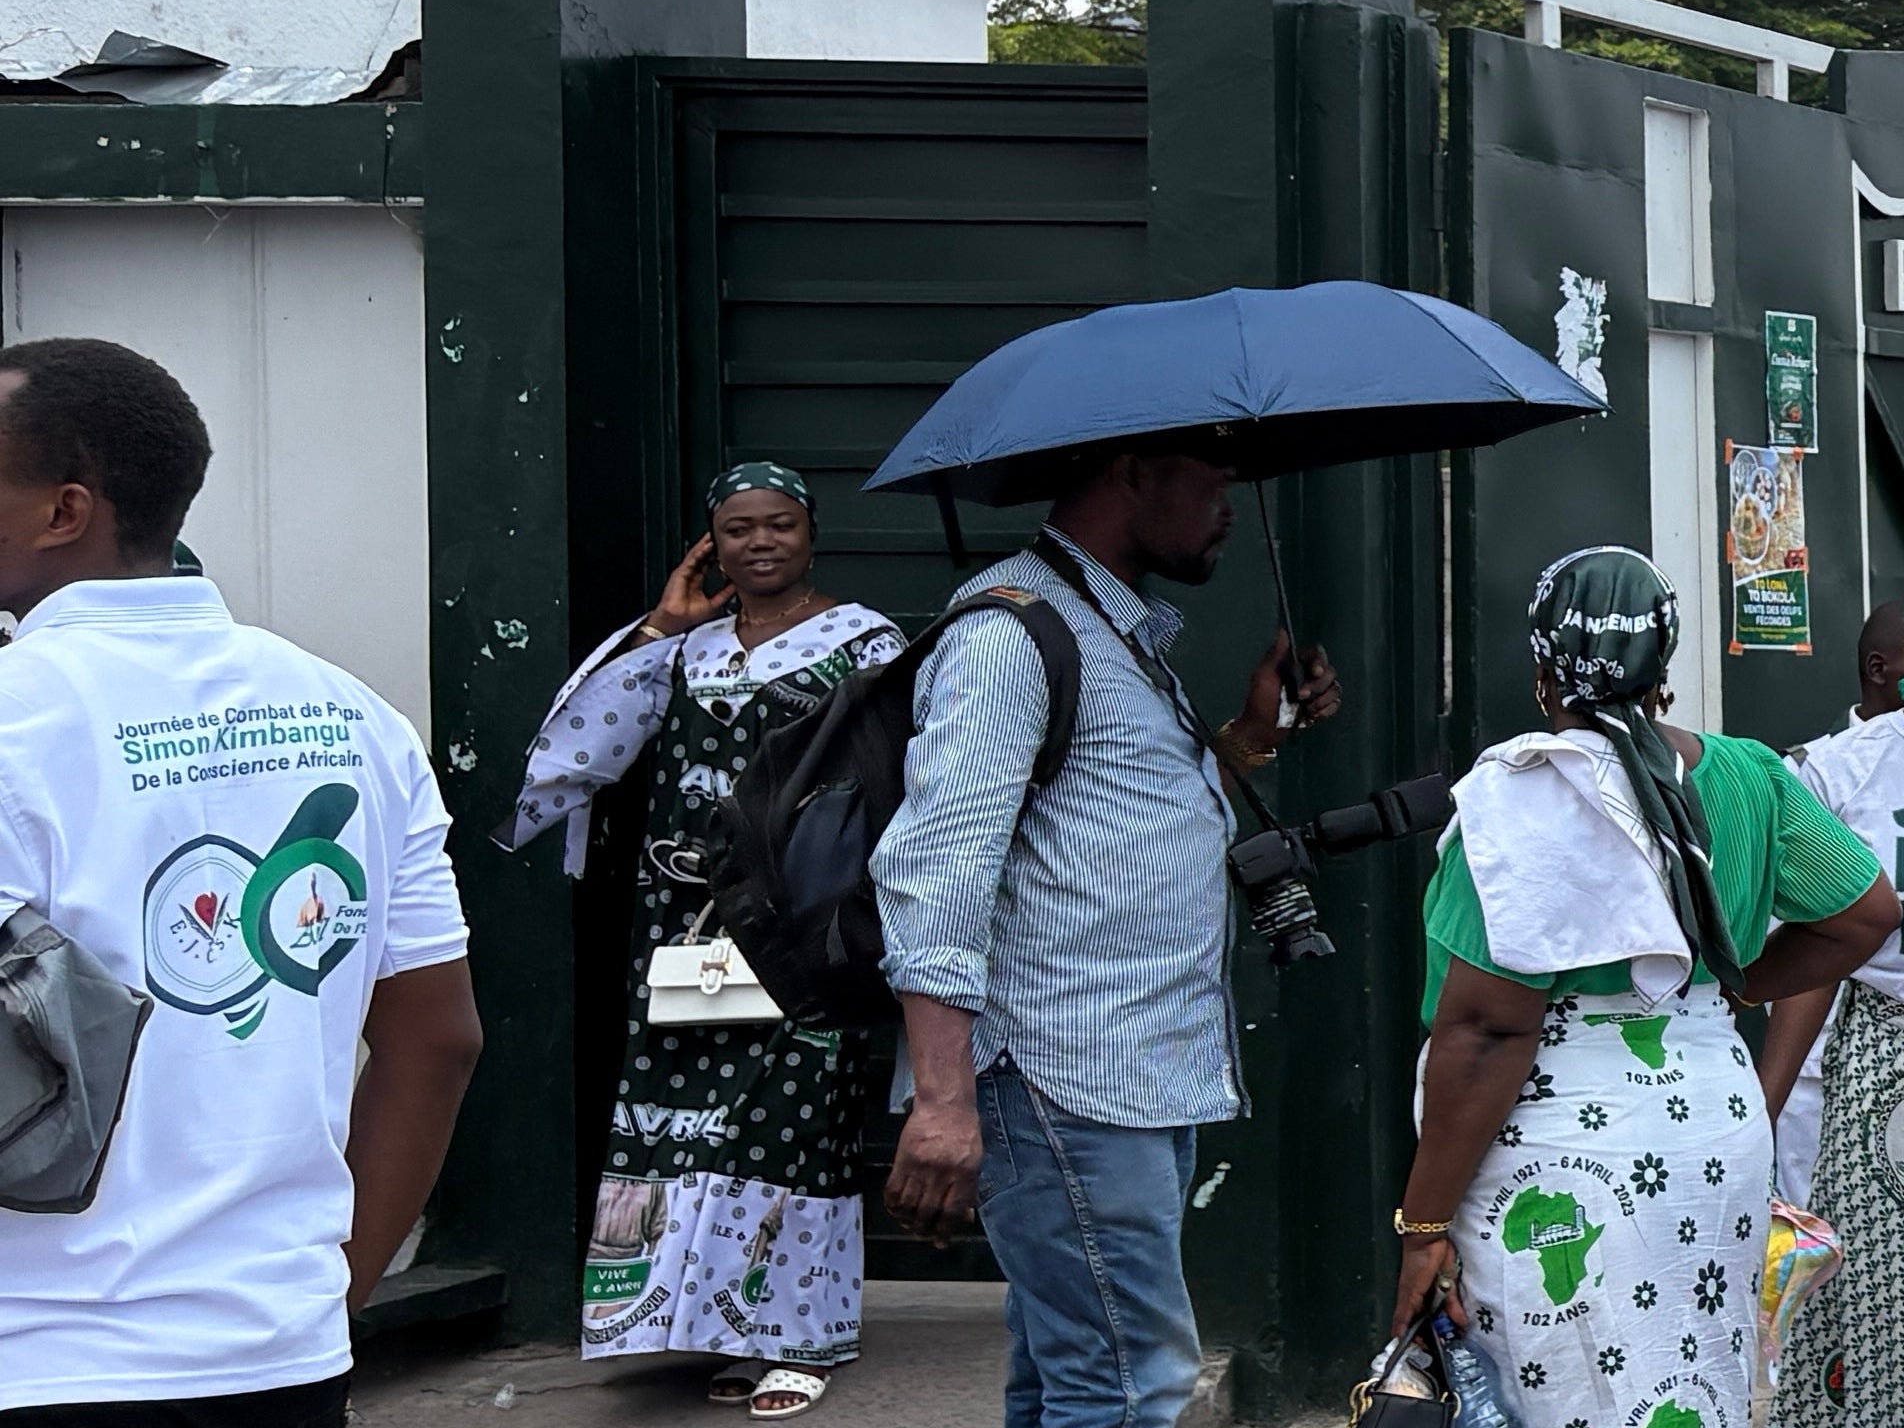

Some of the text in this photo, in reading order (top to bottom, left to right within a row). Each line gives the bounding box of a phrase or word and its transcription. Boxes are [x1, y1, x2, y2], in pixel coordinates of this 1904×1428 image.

[114, 715, 195, 740] Journée
[197, 712, 221, 730] de
[225, 703, 296, 725] Combat
[300, 702, 322, 719] de
[121, 722, 350, 765] Simon Kimbangu
[132, 773, 161, 792] De
[166, 768, 183, 786] la
[296, 749, 363, 770] Africain
[1625, 1067, 1686, 1088] 102 ANS
[1485, 1185, 1514, 1226] AVRIL
[1512, 1160, 1543, 1185] 1921
[1560, 1156, 1570, 1169] 6
[1572, 1156, 1614, 1186] AVRIL
[1612, 1184, 1636, 1218] 2023
[1522, 1300, 1591, 1327] 102 ANS
[1653, 1375, 1679, 1398] 1921
[1691, 1373, 1699, 1387] 6
